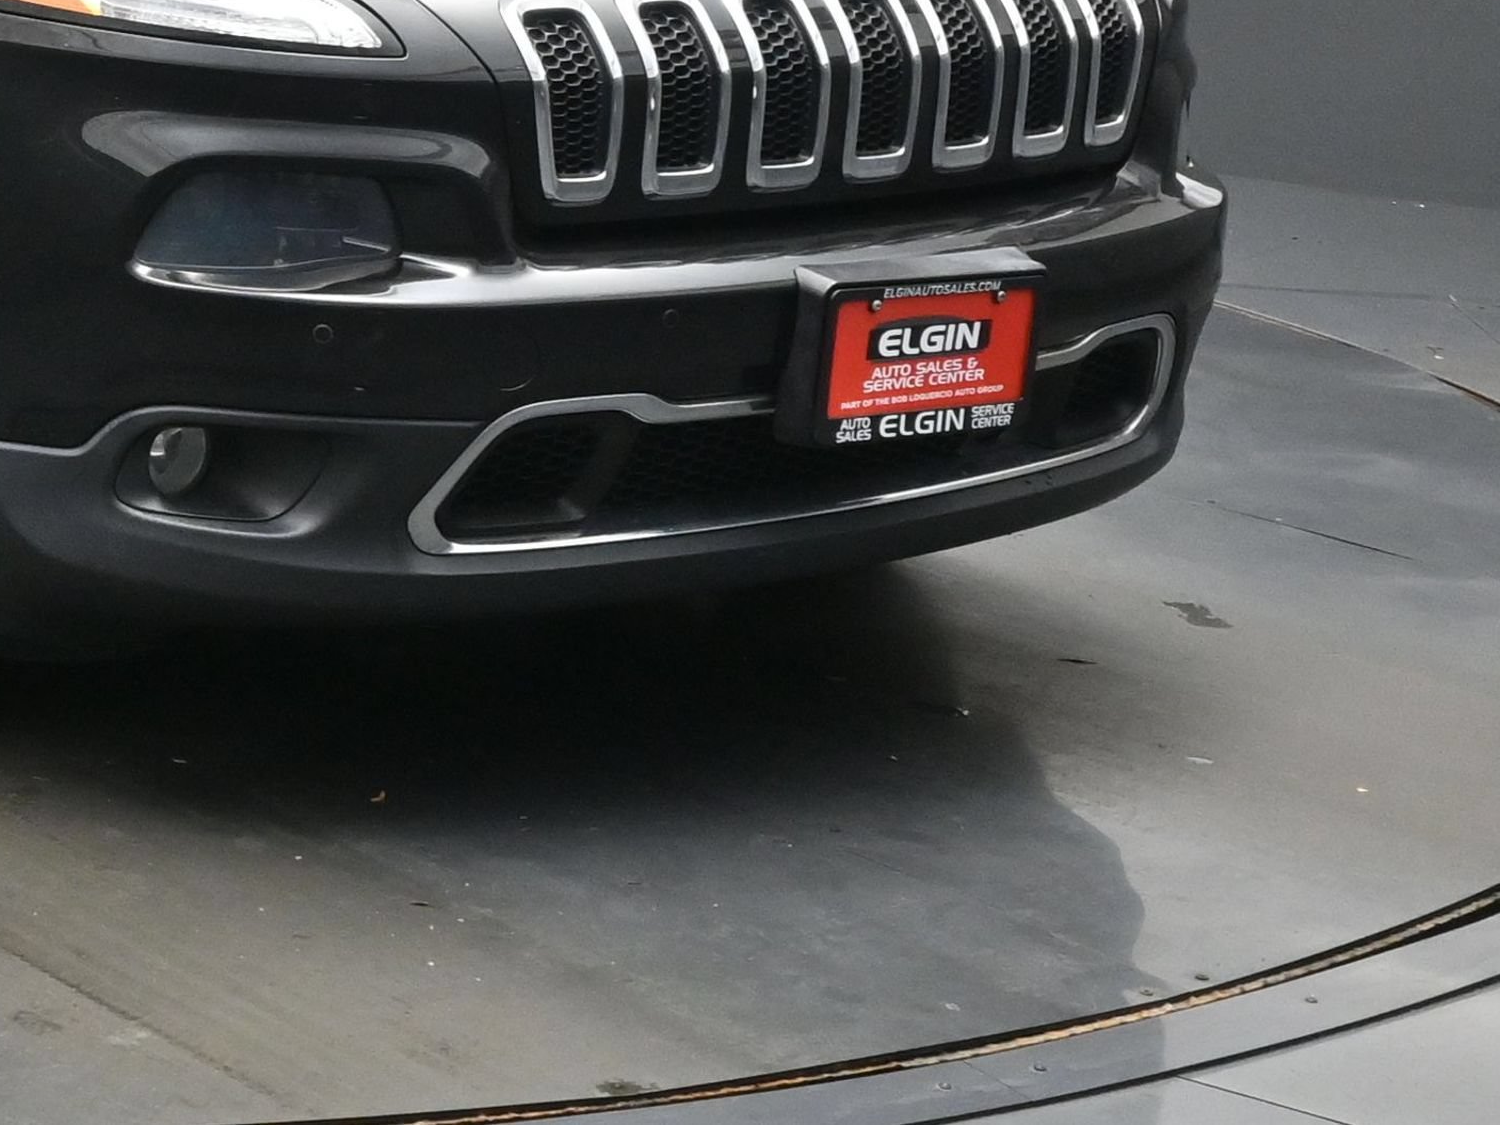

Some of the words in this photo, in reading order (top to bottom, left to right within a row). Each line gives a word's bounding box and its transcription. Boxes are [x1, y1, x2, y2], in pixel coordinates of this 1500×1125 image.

[883, 281, 1002, 299] ELGINAUTOSALES.COM
[878, 321, 982, 357] ELGIN
[871, 362, 912, 380] AUTO
[916, 358, 962, 374] SALES
[966, 357, 979, 368] &
[863, 375, 924, 393] SERVICE
[928, 368, 985, 387] CENTER
[840, 400, 861, 410] PART
[862, 399, 874, 408] OF
[875, 397, 890, 406] THE
[954, 386, 976, 396] AUTO
[977, 384, 1004, 394] GROUP
[971, 402, 1015, 418] SERVICE
[839, 417, 871, 431] AUTO
[878, 408, 965, 438] ELGIN
[971, 414, 1012, 429] CENTER
[835, 428, 872, 444] SALES
